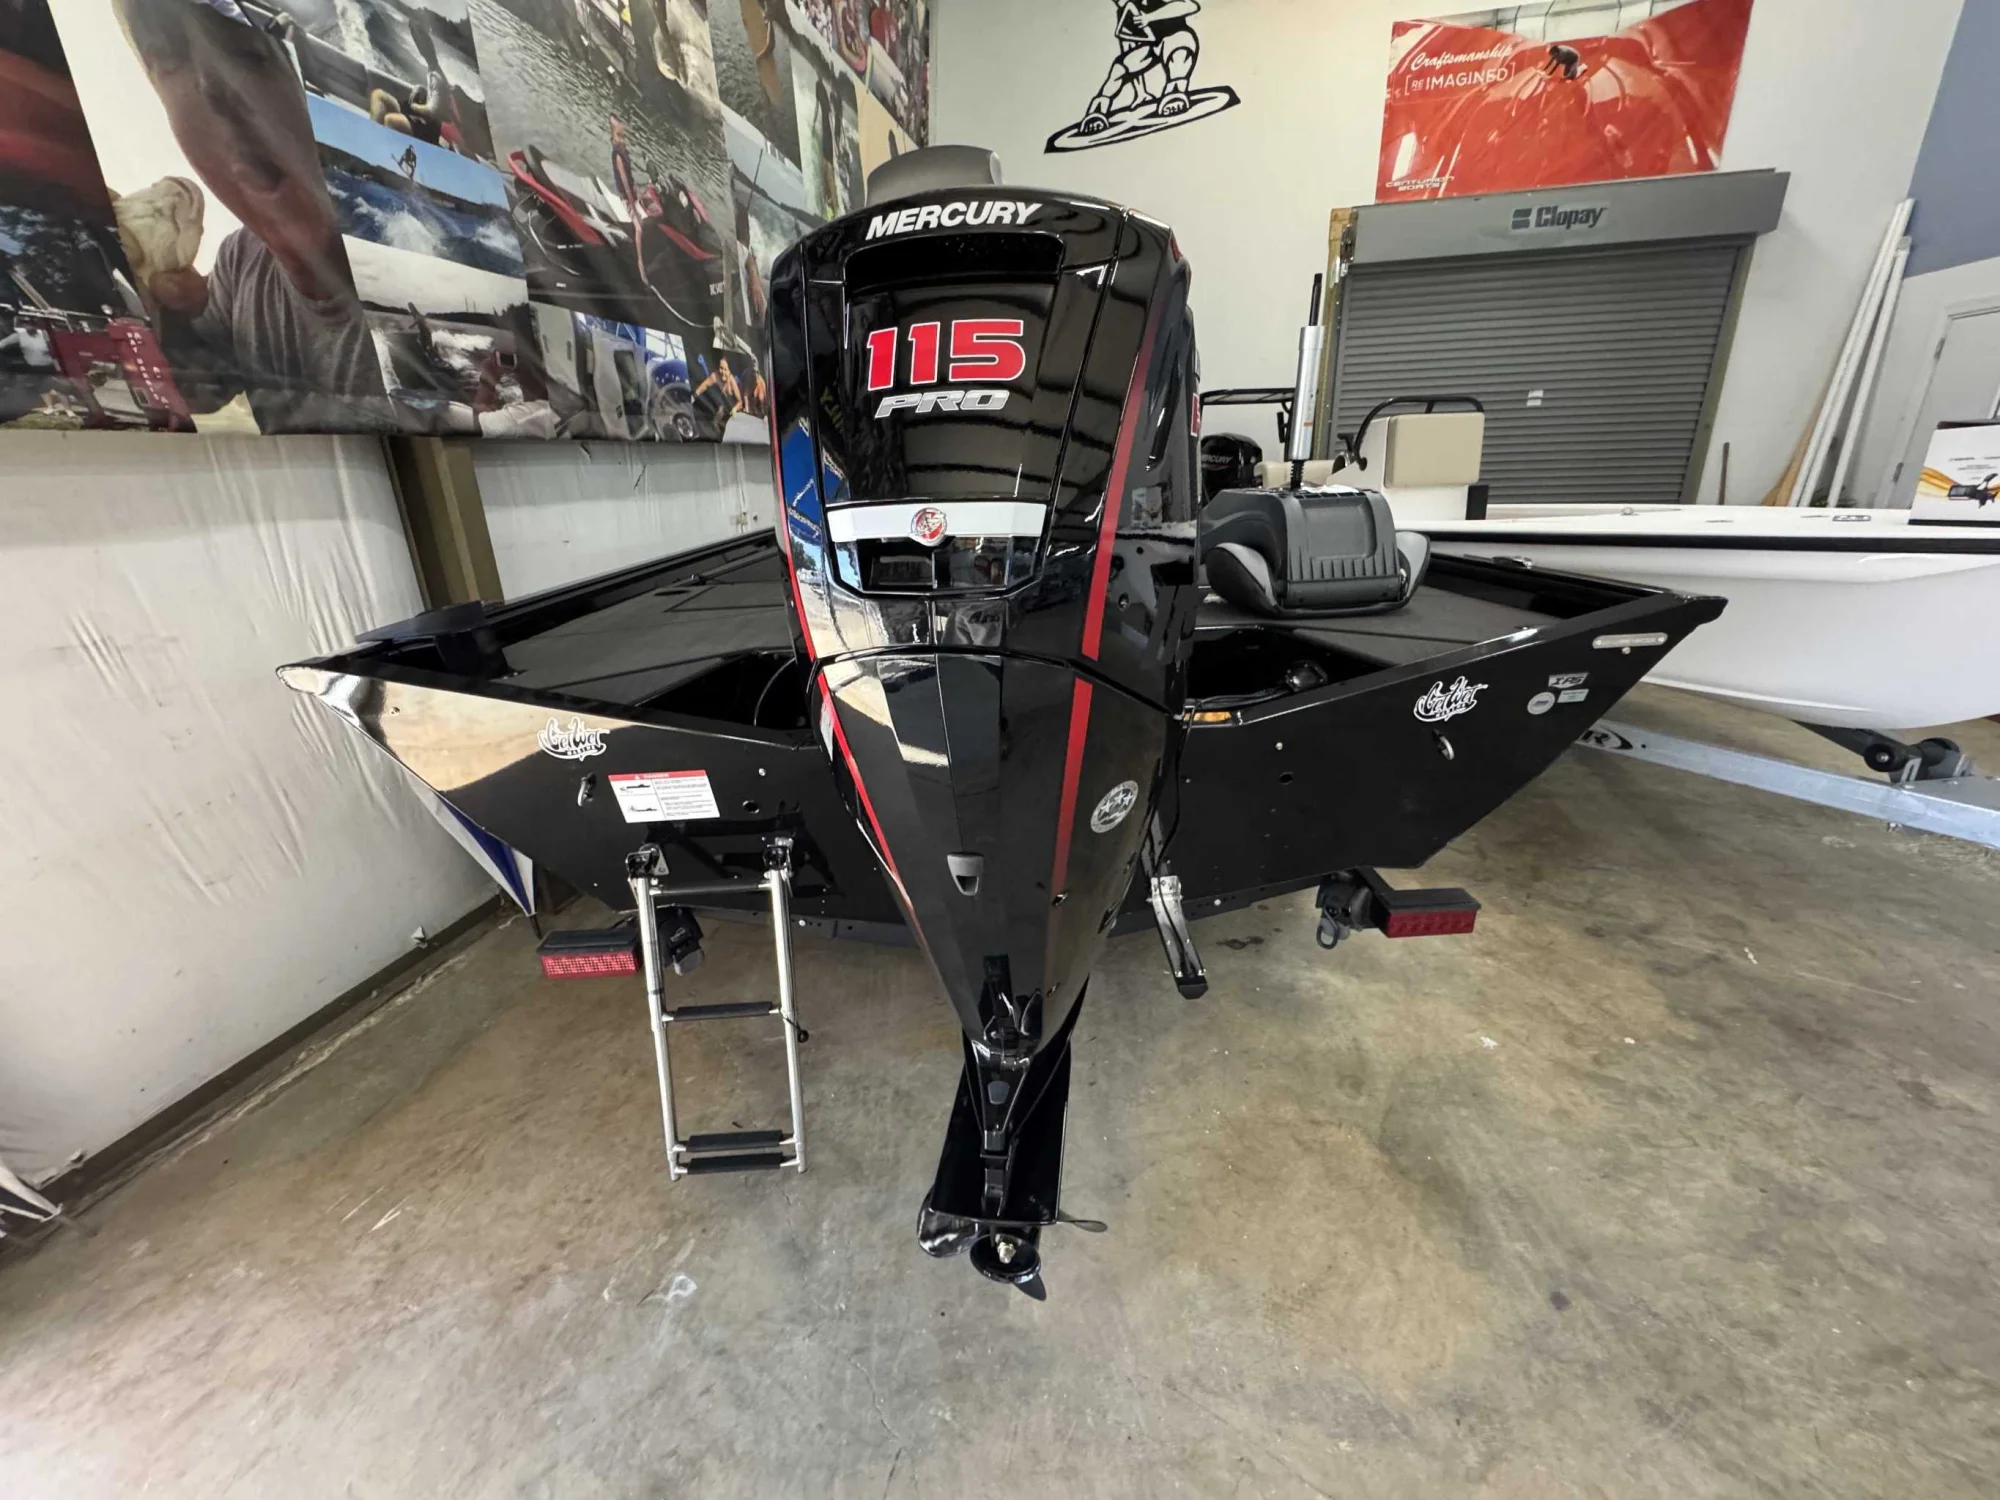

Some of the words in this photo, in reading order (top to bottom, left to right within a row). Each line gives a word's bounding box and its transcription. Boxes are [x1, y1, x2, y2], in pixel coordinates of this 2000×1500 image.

[1411, 43, 1513, 71] Craftsmanship
[865, 201, 1043, 241] MERCURY
[1535, 205, 1605, 230] Clopay
[867, 318, 1026, 391] 115
[874, 390, 1010, 419] PRO
